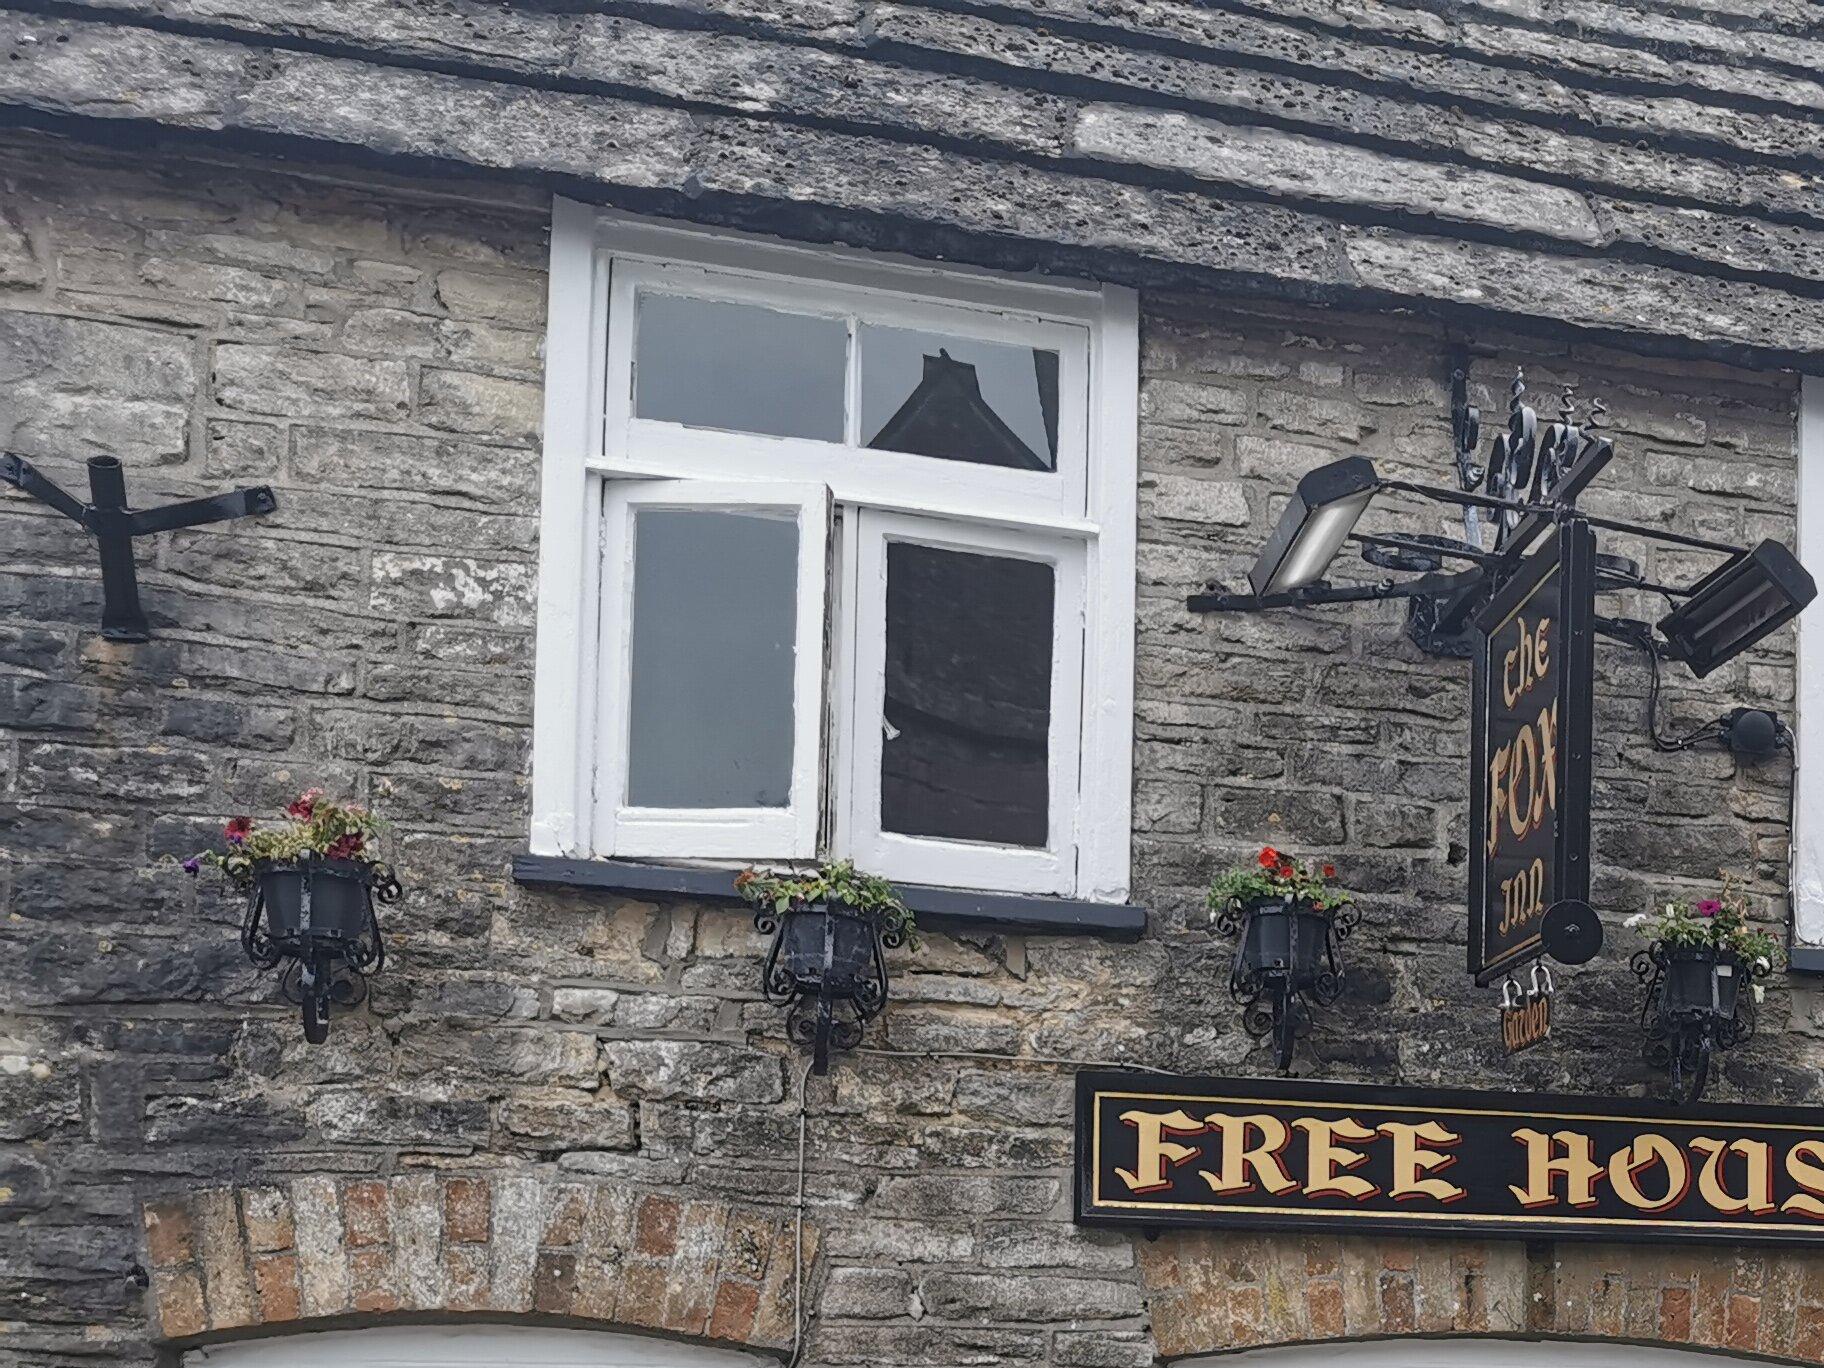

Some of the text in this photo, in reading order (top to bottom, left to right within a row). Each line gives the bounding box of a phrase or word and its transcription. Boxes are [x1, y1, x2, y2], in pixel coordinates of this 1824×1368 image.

[1503, 615, 1551, 711] the
[1488, 697, 1558, 860] FOX
[1503, 997, 1549, 1054] Garden
[1115, 1108, 1467, 1201] FREE
